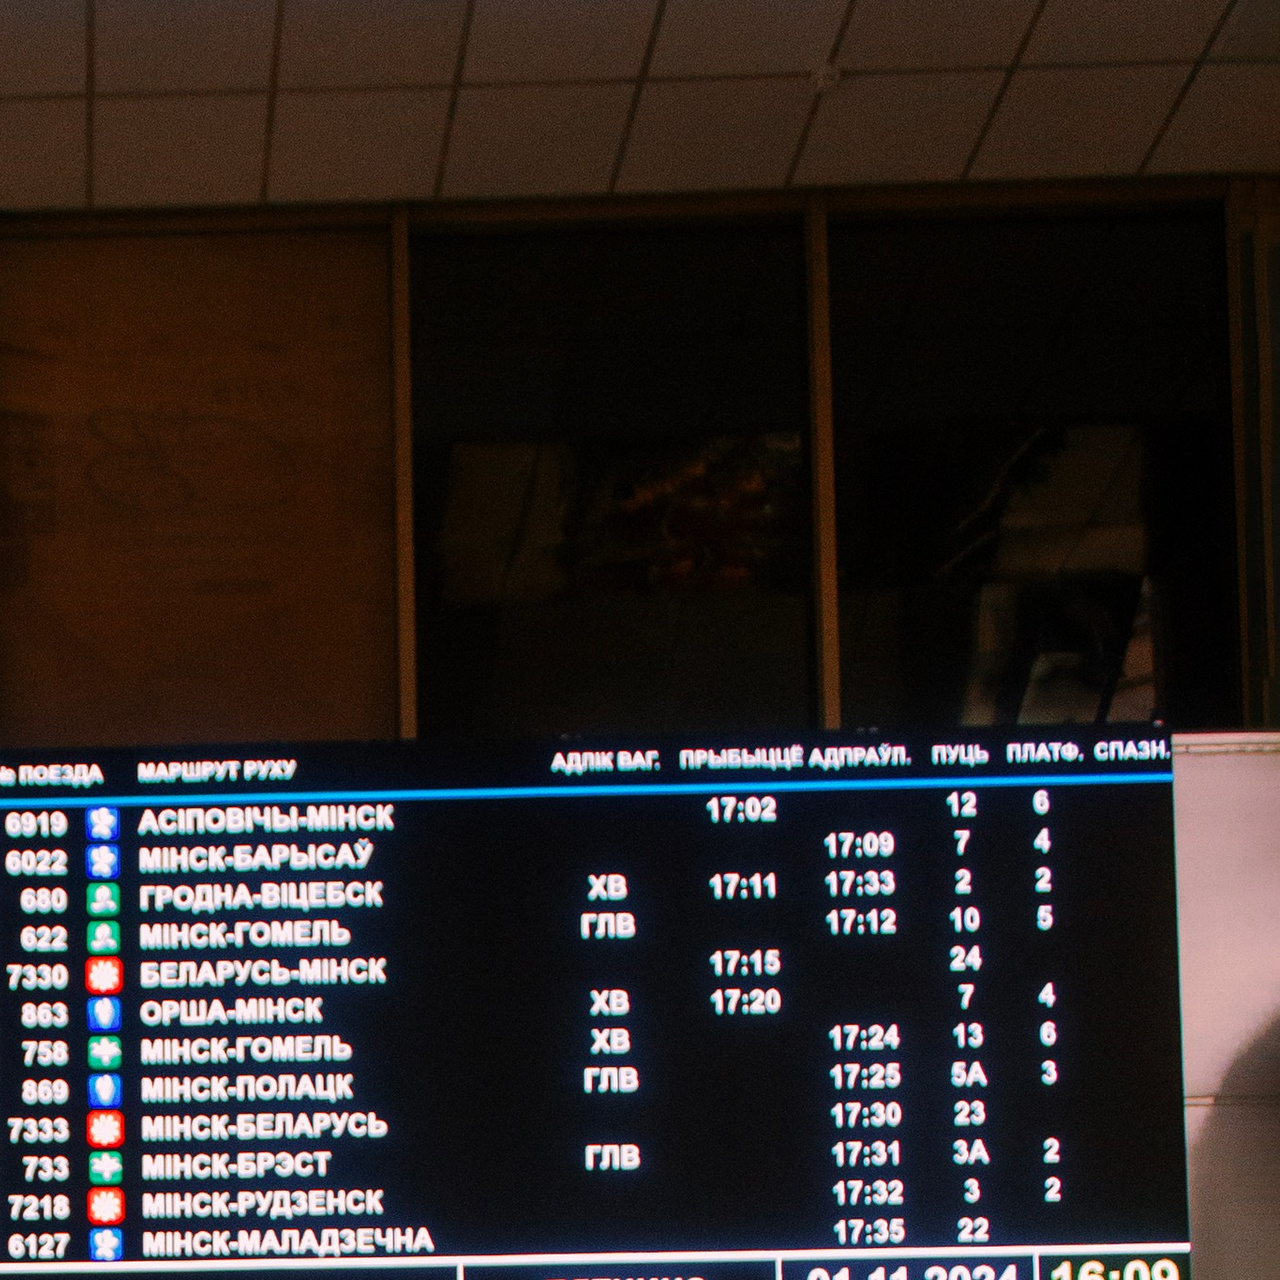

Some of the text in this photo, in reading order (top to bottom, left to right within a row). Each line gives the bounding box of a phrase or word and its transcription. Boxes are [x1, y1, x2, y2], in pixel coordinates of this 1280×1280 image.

[137, 760, 241, 783] МАРШРУТ
[243, 759, 298, 781] РУХУ
[931, 744, 990, 768] ПУЦЬ
[5, 789, 1050, 837] 6919 АСІПОВІЧЫ-МІНСК 17:02 12 6
[5, 829, 970, 876] 6022 МІНСК-БАРЫСАЎ 17:09 7
[20, 868, 972, 914] 680 ГРОДНА-ВІЦЕБСК ХВ 17:11 17:33 2
[20, 905, 1053, 952] 622 МІНСК-ГОМЕЛЬ ГЛВ 17:12 10 5
[7, 945, 982, 990] 7330 БЕЛАРУСЬ-МІНСК 17:15 24
[21, 982, 1056, 1028] 863 ОРША-МІНСК ХВ 17:20 7 4
[22, 1020, 1057, 1066] 758 МІНСК-ГОМЕЛЬ ХВ 17:24 13 6
[22, 1078, 69, 1105] 869
[141, 1073, 353, 1103] МІНСК-ПОЛАЦК
[584, 1066, 639, 1093] ГЛВ
[830, 1062, 901, 1089] 17:25
[1041, 1060, 1058, 1085] 3
[8, 1099, 986, 1143] 7333 МІНСК-БЕЛАРУСЬ 17:30 23
[23, 1155, 69, 1181] 733
[142, 1150, 332, 1180] МІНСК-БРЭСТ
[585, 1144, 641, 1170] ГЛВ
[832, 1140, 900, 1167] 17:31
[1043, 1137, 1060, 1163] 2
[8, 1176, 1061, 1220] 7218 МІНСК-РУДЗЕНСК 17:32 3 2
[8, 1217, 990, 1258] 6127 МІНСК-МАЛАДЗЕЧНА 17:35 22
